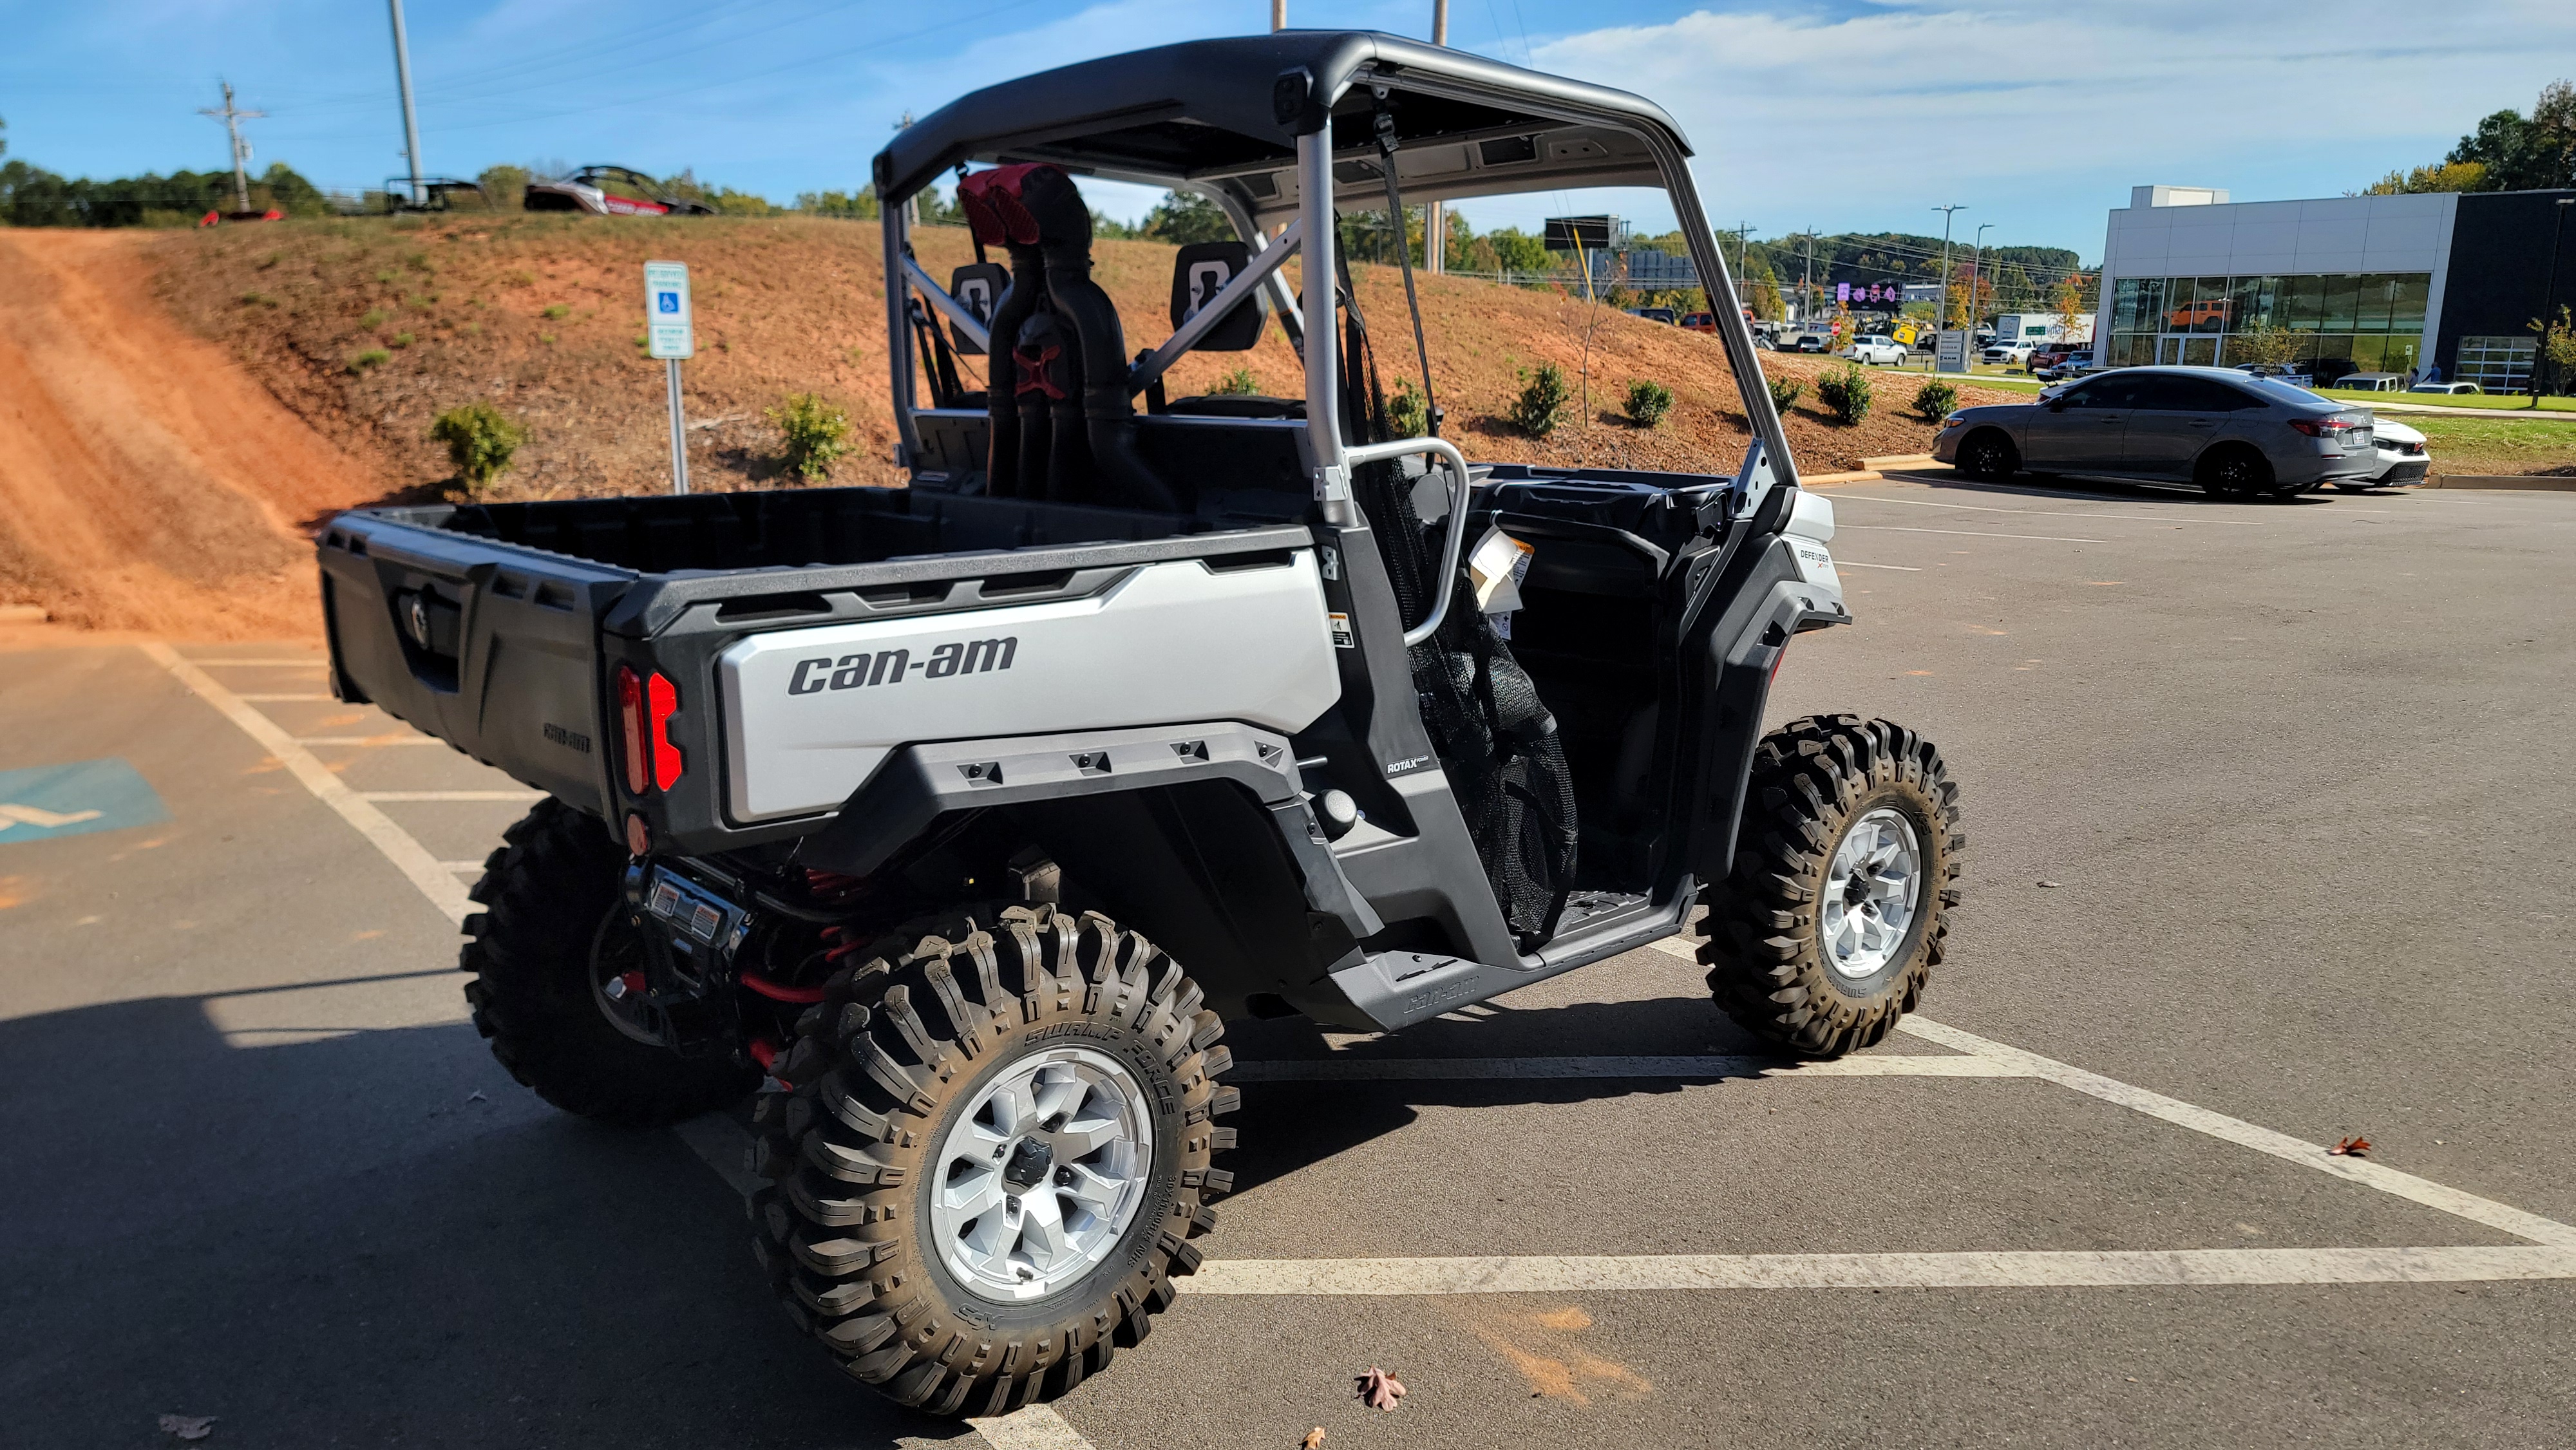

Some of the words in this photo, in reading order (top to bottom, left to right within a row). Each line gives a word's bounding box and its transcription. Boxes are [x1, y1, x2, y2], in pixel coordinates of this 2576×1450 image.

[1801, 549, 1829, 563] DEFENDER
[788, 636, 1018, 695] can-am
[1387, 758, 1417, 774] ROTAX
[1024, 1021, 1125, 1048] SWAMP
